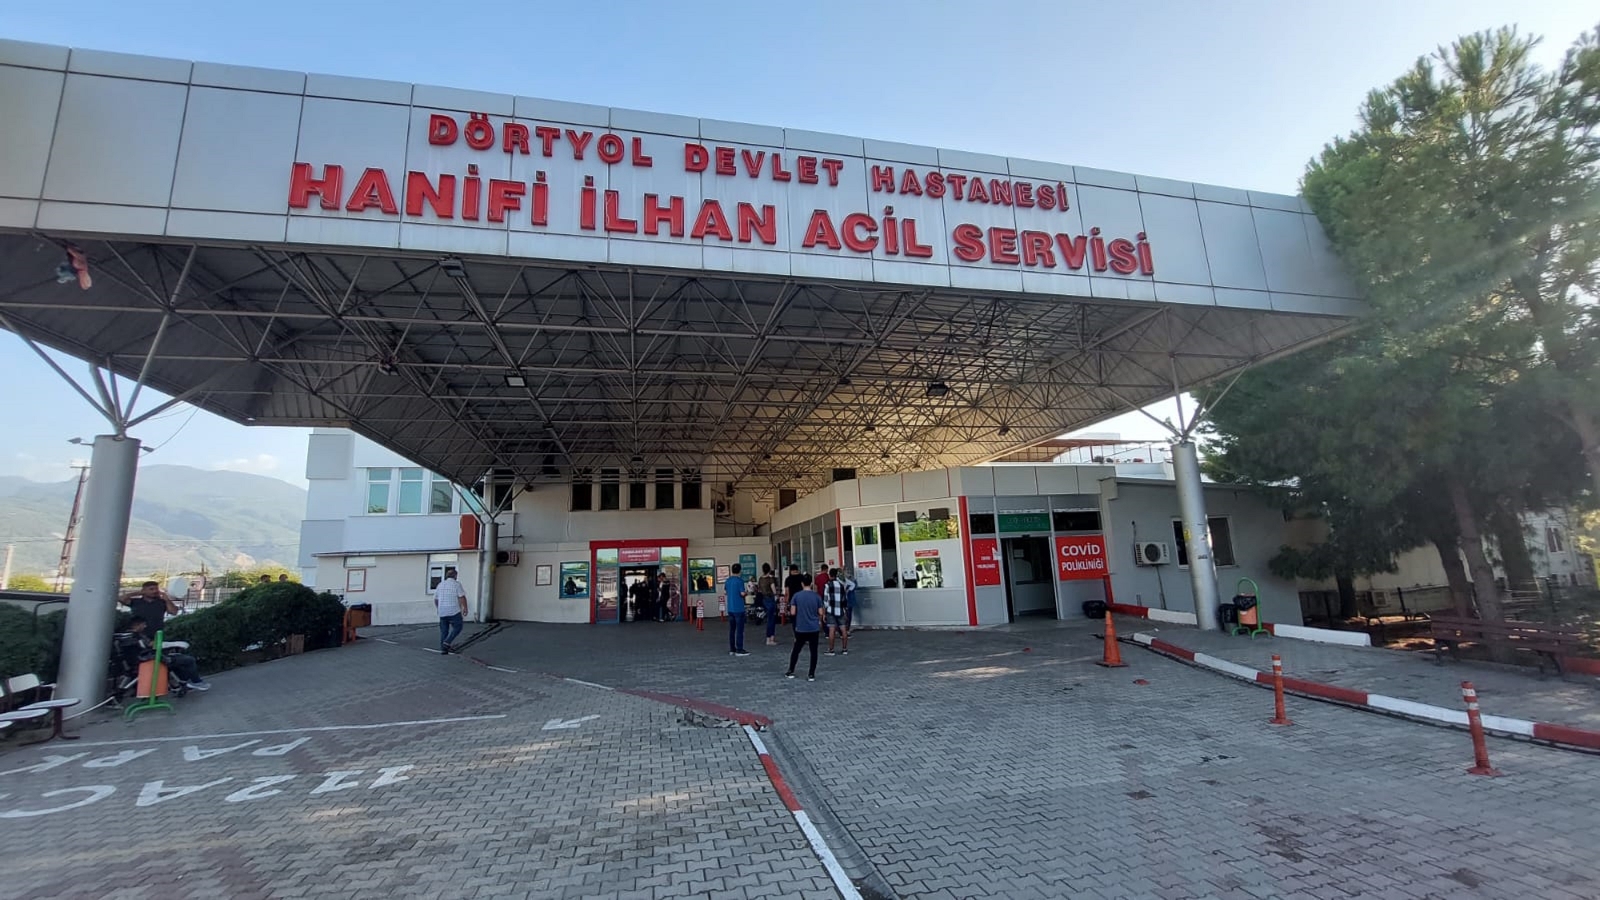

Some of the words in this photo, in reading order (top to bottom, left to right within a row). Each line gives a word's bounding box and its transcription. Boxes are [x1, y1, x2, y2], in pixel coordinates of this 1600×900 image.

[428, 112, 652, 168] DÖRTYOL
[685, 142, 843, 187] DEVLET
[872, 164, 1070, 212] HASTANESİ
[288, 162, 549, 227] HANİFİ
[580, 174, 777, 245] İLHAN
[802, 205, 933, 258] ACİL
[953, 223, 1154, 276] SERVİSİ
[1061, 542, 1100, 557] COVİD
[225, 763, 414, 803] 112
